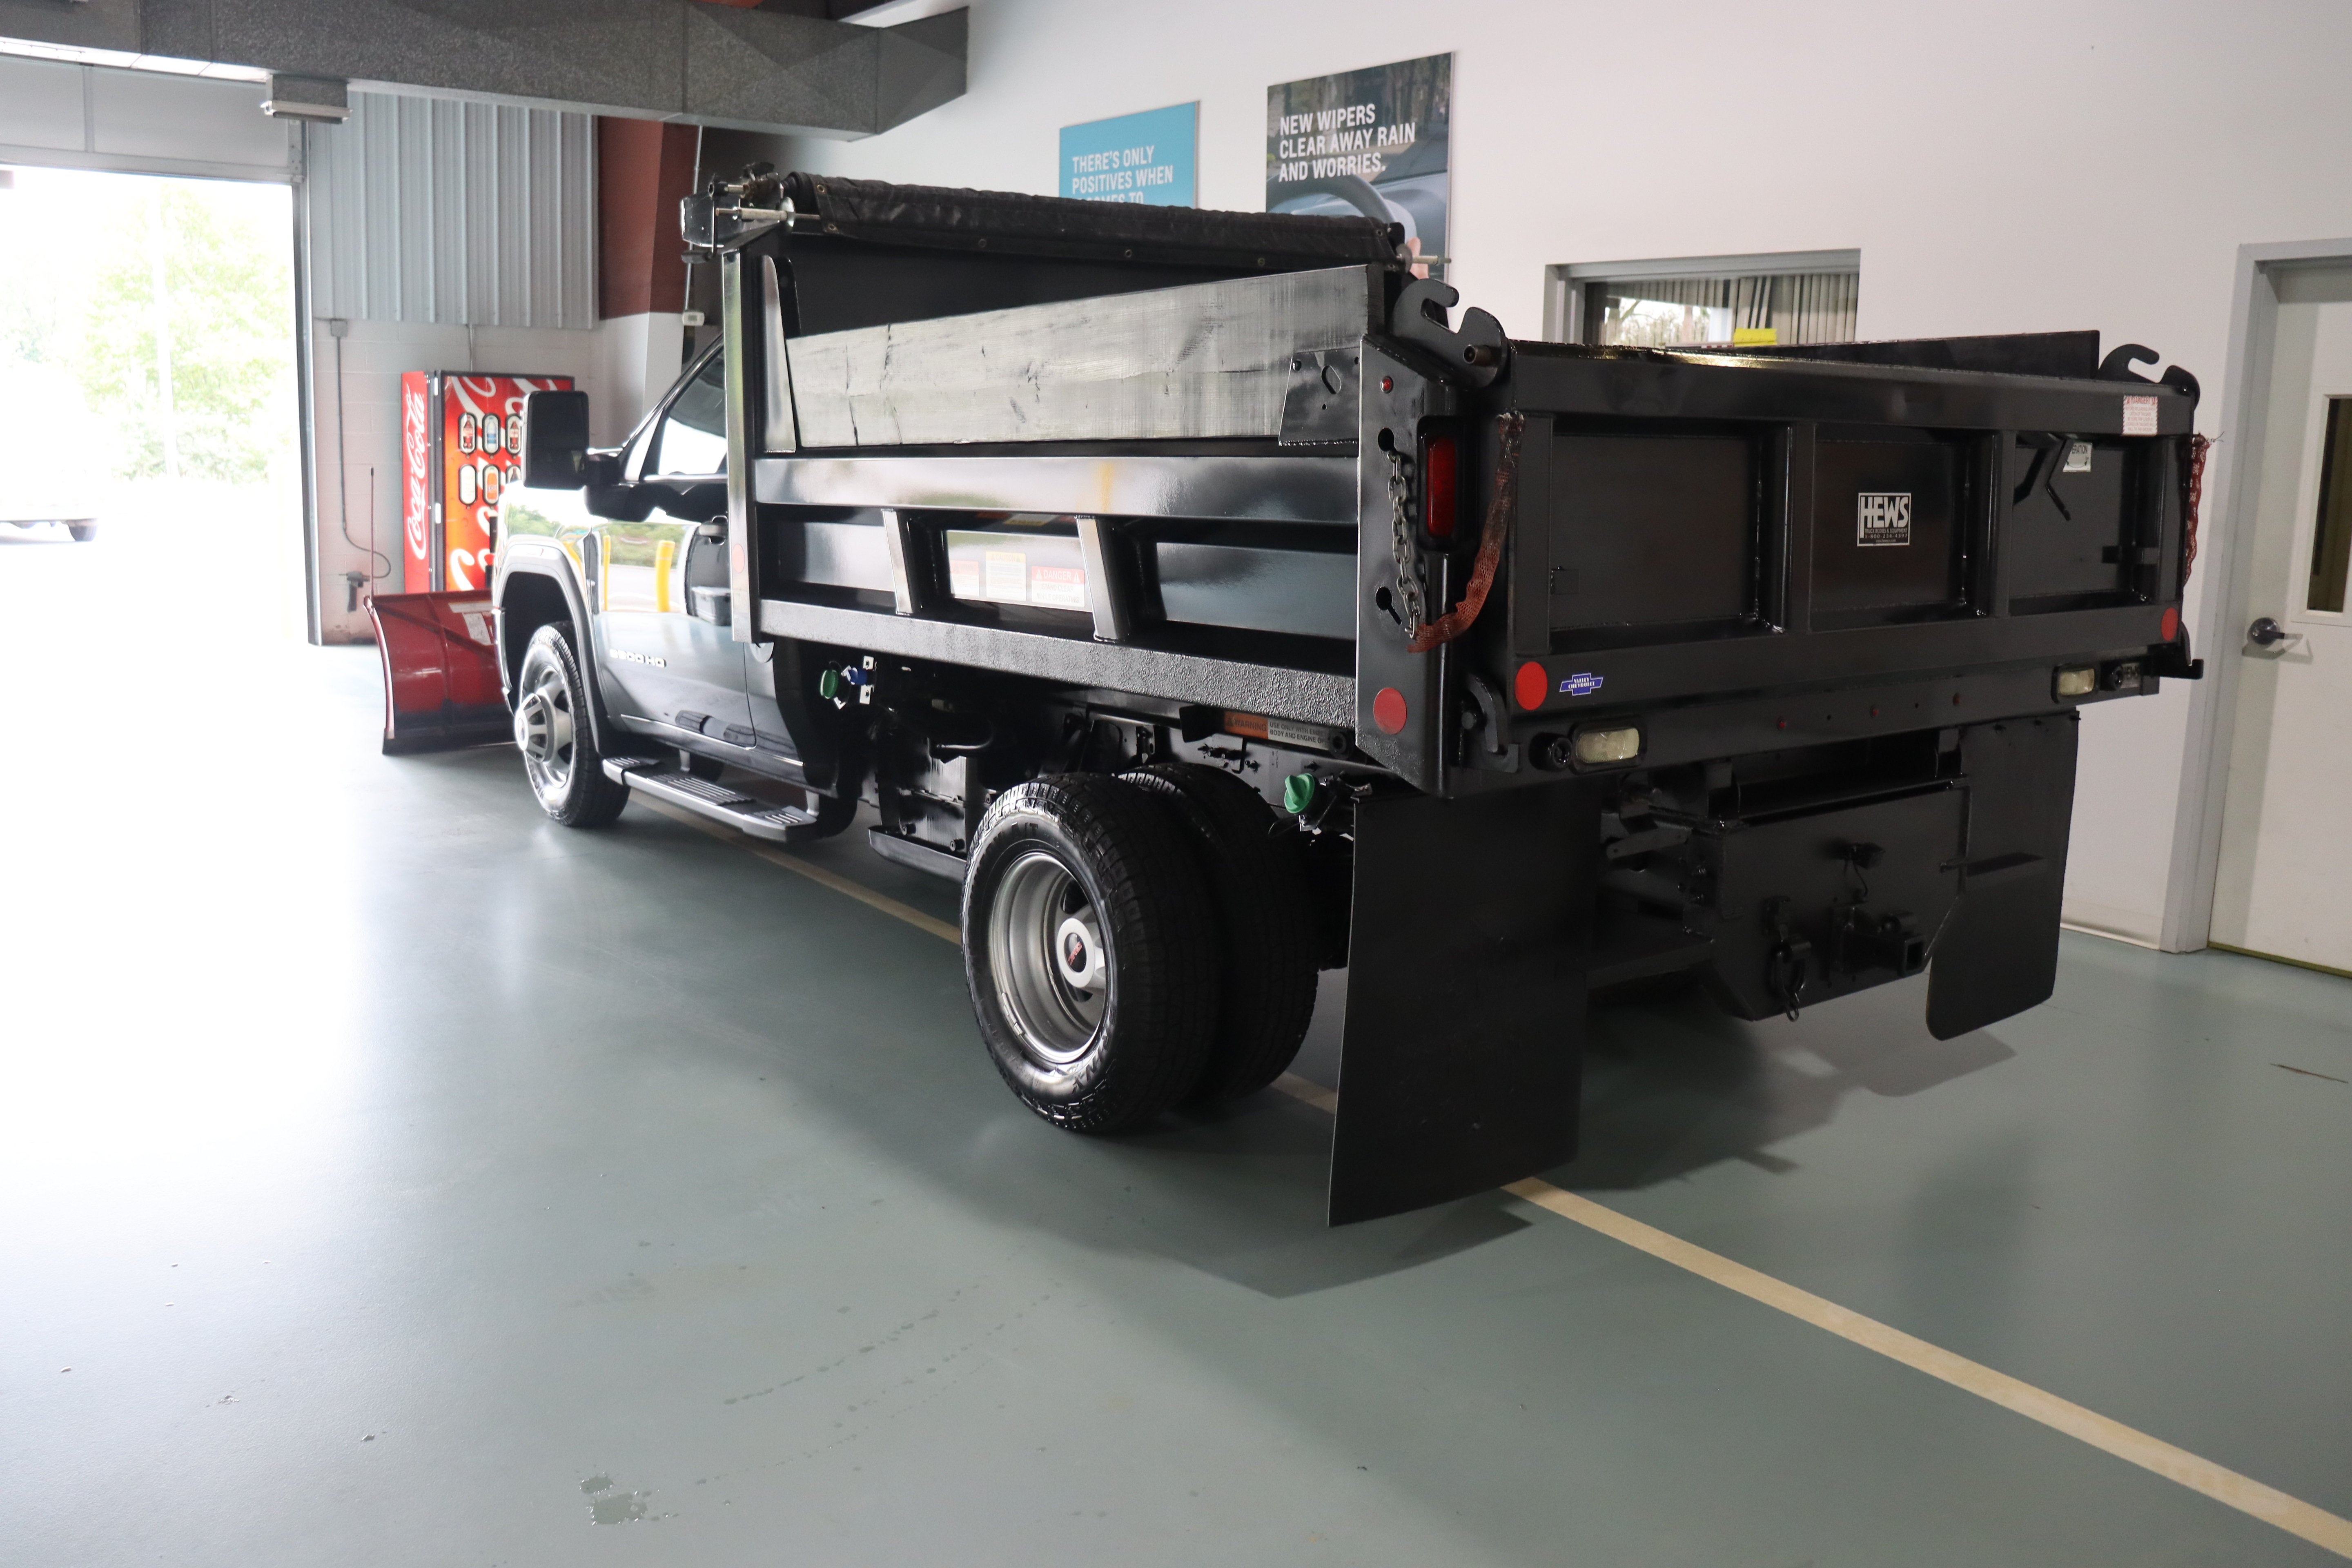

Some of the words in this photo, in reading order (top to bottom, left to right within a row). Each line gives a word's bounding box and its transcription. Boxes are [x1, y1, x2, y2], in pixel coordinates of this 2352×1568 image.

[1280, 113, 1313, 136] NEW
[1317, 103, 1376, 131] WIPERS
[1280, 135, 1325, 159] CLEAR
[1330, 128, 1373, 153] AWAY
[1377, 122, 1416, 147] RAIN
[1072, 150, 1120, 174] THERE'S
[1123, 145, 1155, 167] ONLY
[1278, 161, 1308, 183] AND
[1312, 152, 1386, 179] WORRIES.
[1072, 171, 1132, 194] POSITIVES
[1136, 165, 1174, 187] WHEN
[406, 382, 426, 560] Coca-Cola
[1860, 497, 1909, 538] HEWS
[1044, 569, 1071, 581] DANGER
[1058, 585, 1074, 593] CLEAR
[1037, 592, 1051, 601] WHILE
[1052, 594, 1079, 604] OPERATING
[1568, 681, 1595, 689] CHEVROLET
[1235, 719, 1267, 731] WARNING
[1270, 729, 1284, 737] BODY
[1297, 734, 1316, 743] ENGINE
